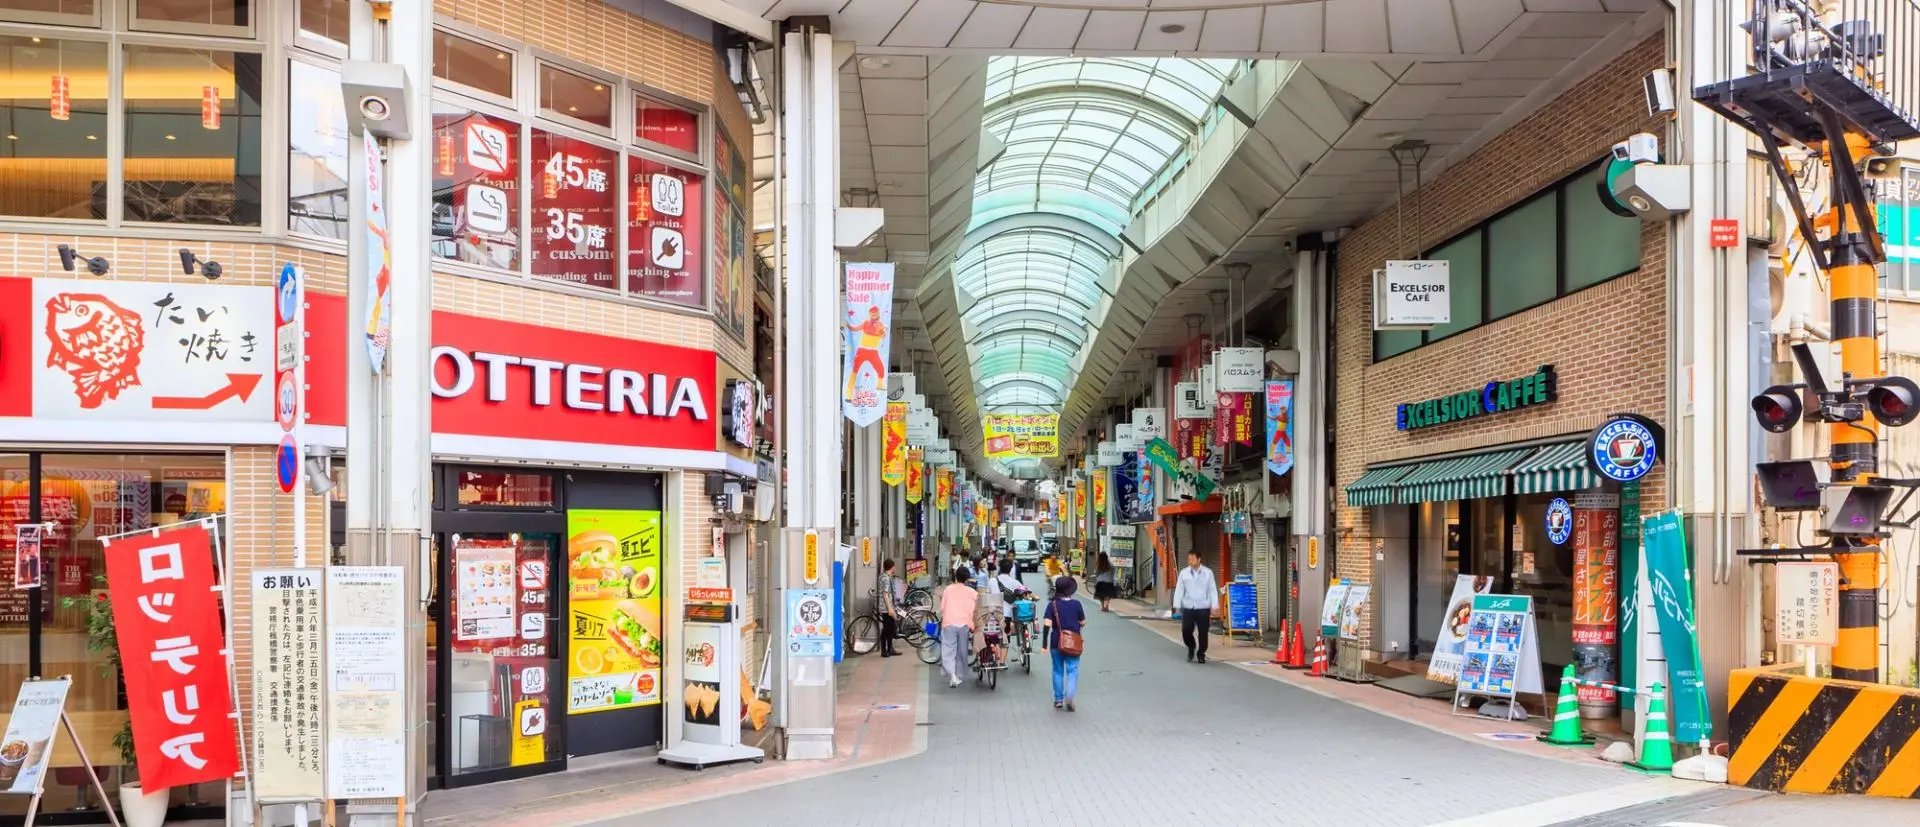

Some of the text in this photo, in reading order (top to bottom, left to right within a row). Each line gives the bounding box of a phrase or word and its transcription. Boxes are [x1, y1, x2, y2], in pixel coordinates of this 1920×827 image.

[657, 202, 679, 214] Toilet
[547, 207, 606, 249] 35席
[848, 269, 880, 280] Happy
[848, 280, 891, 291] Summer
[1391, 282, 1445, 292] EXCELSIOR
[848, 292, 870, 303] Sale
[1405, 292, 1430, 302] CAFÉ
[153, 292, 228, 328] たい
[178, 329, 258, 363] 焼き
[282, 389, 293, 415] 30
[1396, 365, 1547, 431] EXCELSIOR CAFFÉ
[1575, 512, 1588, 621] お部屋さがし
[1603, 512, 1618, 623] お部屋さがし
[263, 575, 311, 589] お願い
[691, 589, 730, 600] いらっしゃいませ
[137, 542, 208, 770] ロッテリア
